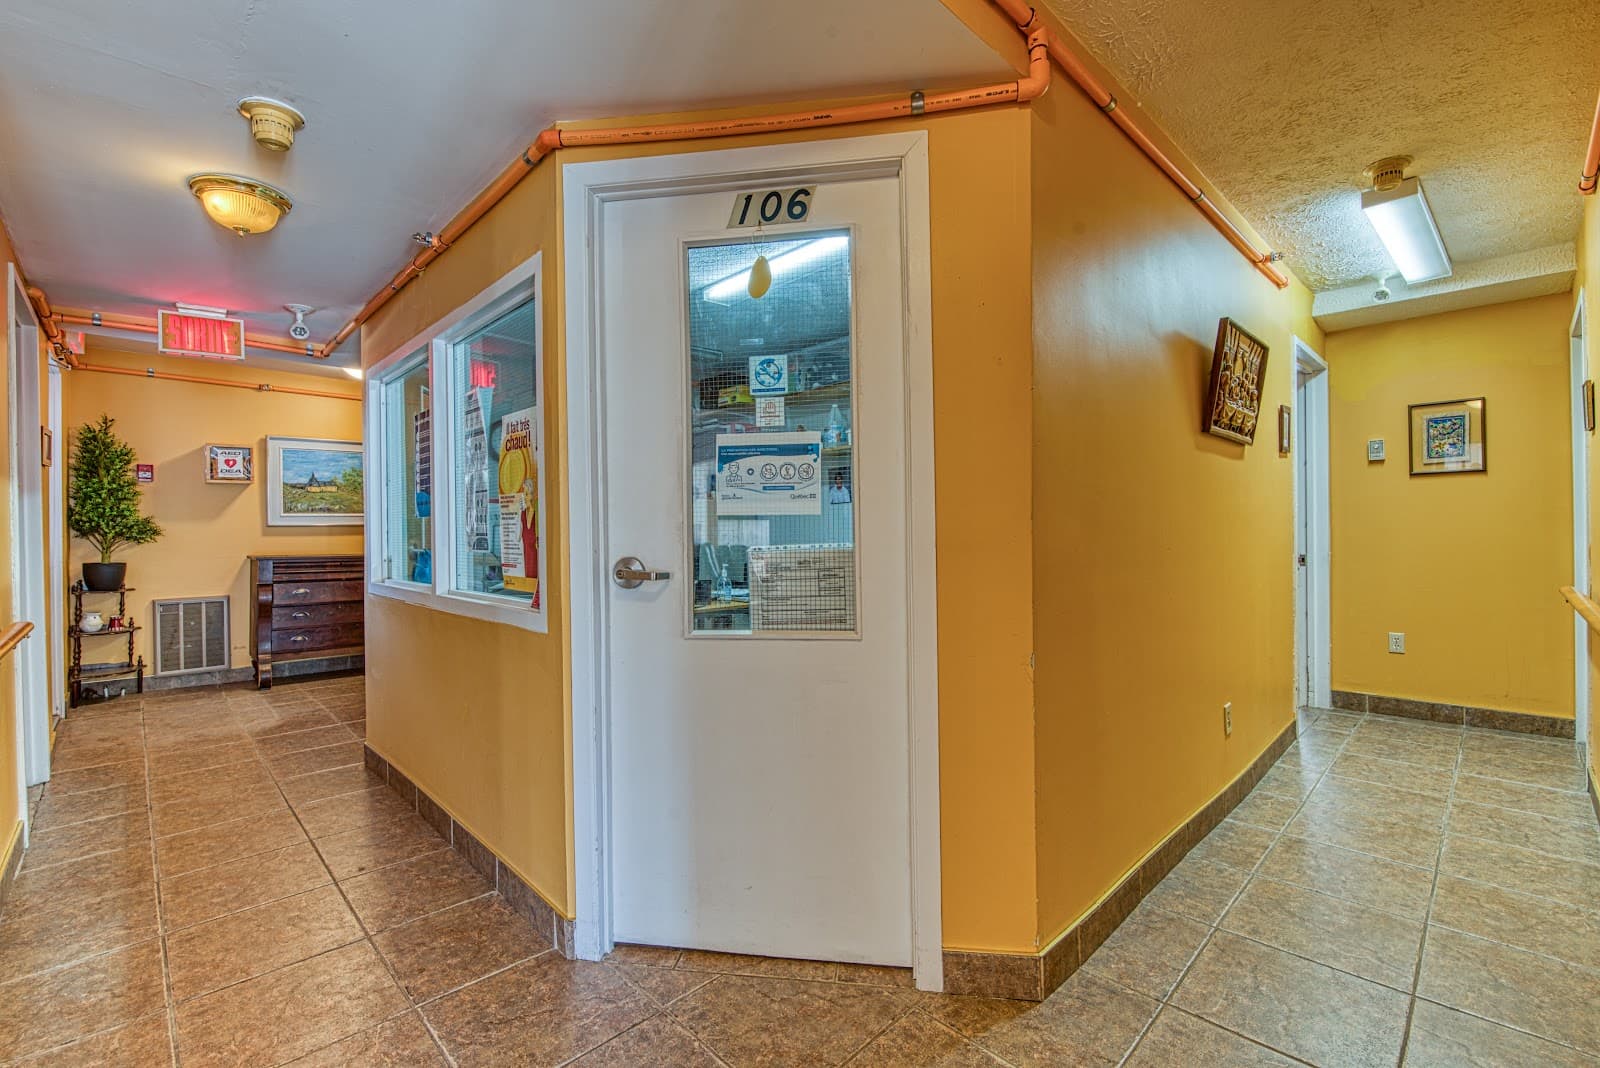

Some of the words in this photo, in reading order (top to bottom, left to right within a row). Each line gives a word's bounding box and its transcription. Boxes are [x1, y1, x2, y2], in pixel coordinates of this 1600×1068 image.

[738, 188, 811, 225] 106
[167, 314, 234, 354] SORTIE
[506, 431, 530, 452] chaud!
[510, 421, 518, 434] fait
